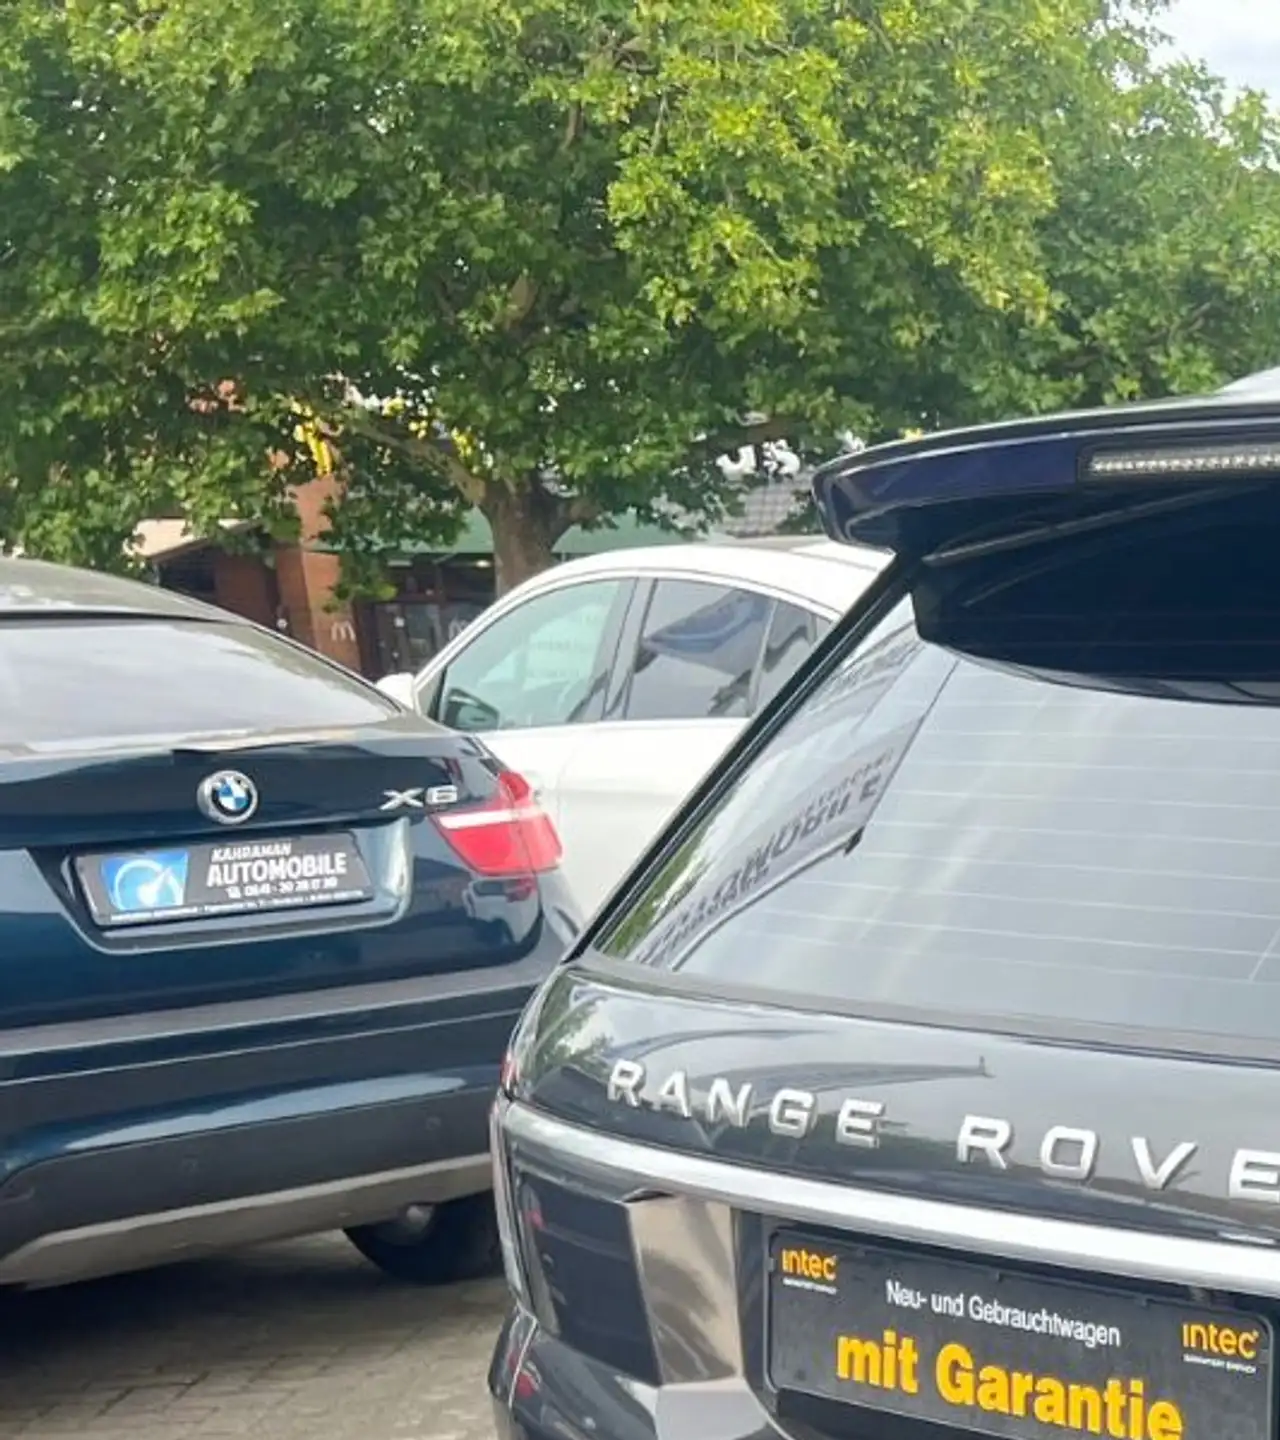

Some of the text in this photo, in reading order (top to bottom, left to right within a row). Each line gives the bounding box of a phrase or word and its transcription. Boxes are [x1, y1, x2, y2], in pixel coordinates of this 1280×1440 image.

[379, 784, 459, 811] X6
[206, 852, 348, 888] AUTOMOBILE
[606, 1059, 886, 1150] RANGE
[885, 1278, 1122, 1349] Neu- und Gebrauchtwagen
[836, 1328, 919, 1394] mit
